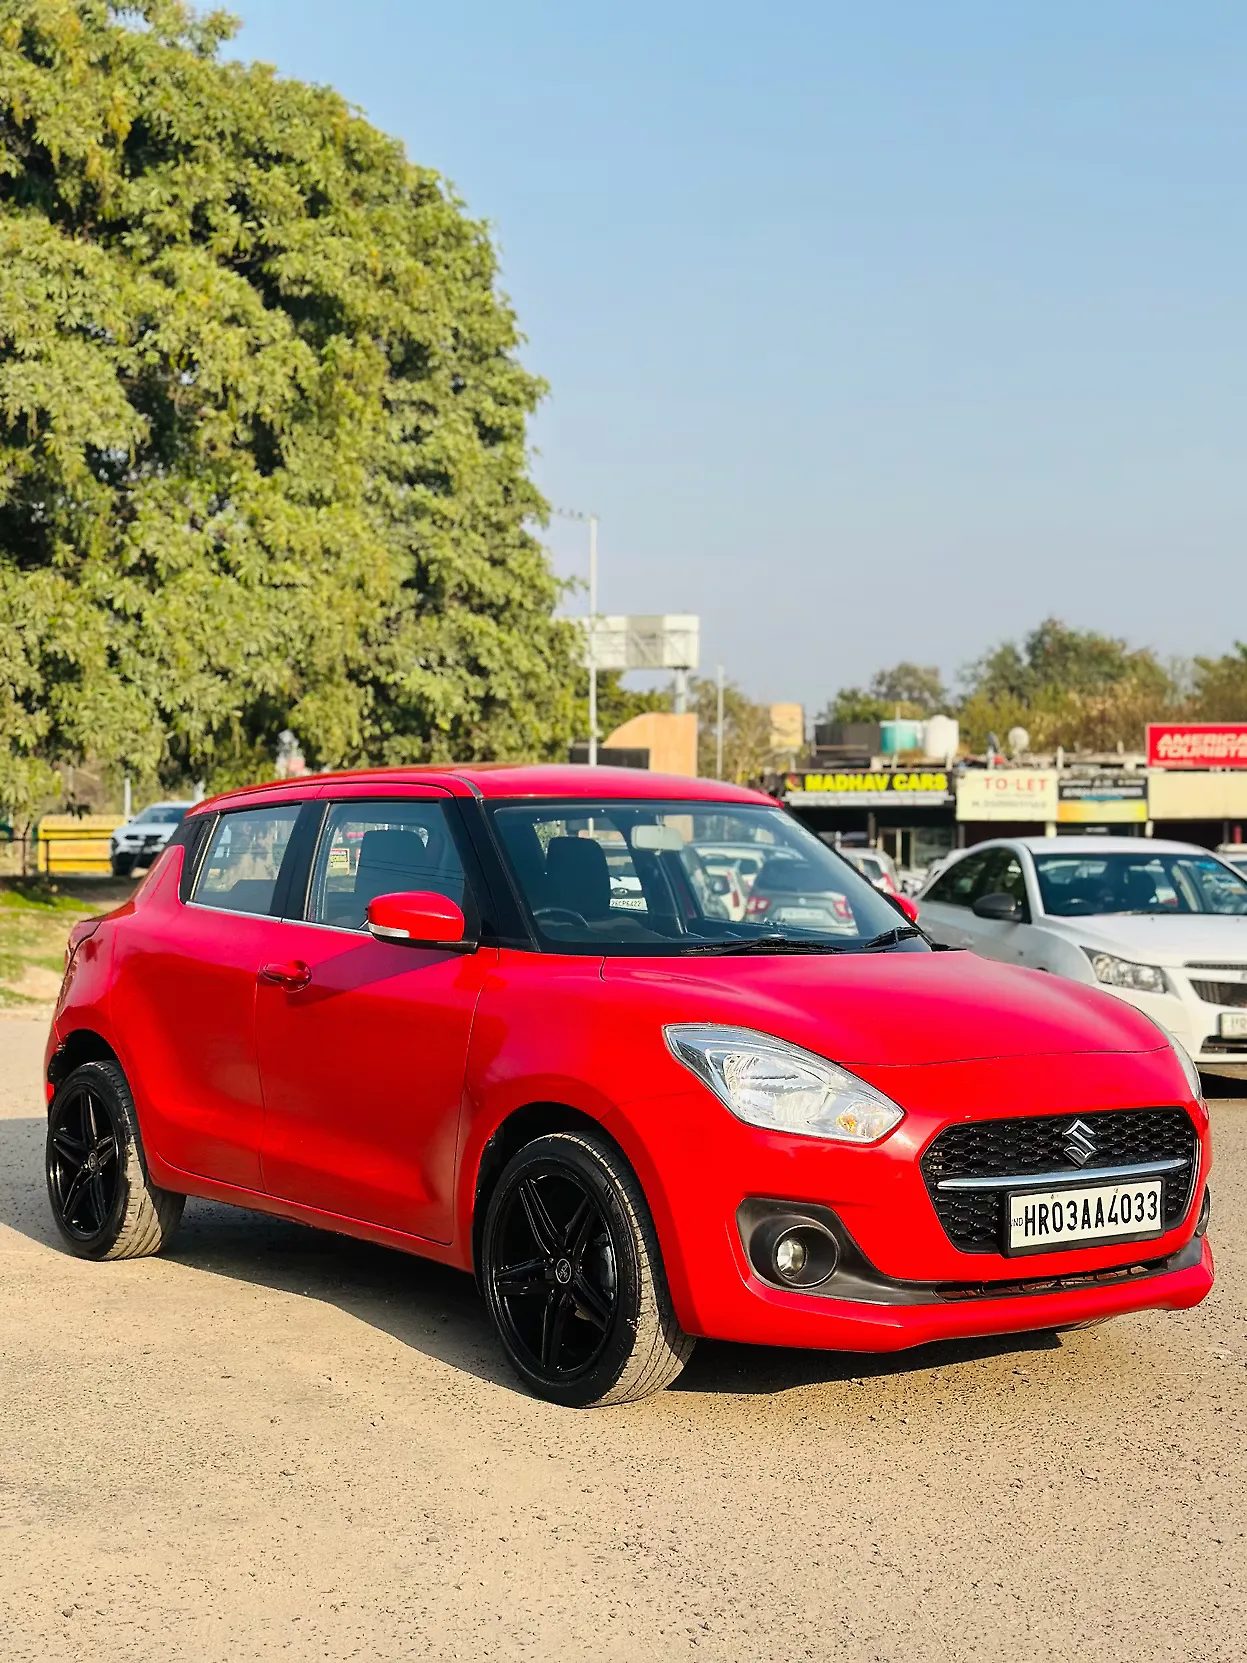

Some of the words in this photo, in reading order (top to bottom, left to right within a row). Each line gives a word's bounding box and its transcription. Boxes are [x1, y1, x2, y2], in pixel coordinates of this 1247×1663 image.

[804, 773, 891, 791] MADHAV
[892, 773, 948, 791] CARS
[1024, 1190, 1158, 1237] HR03AA4033
